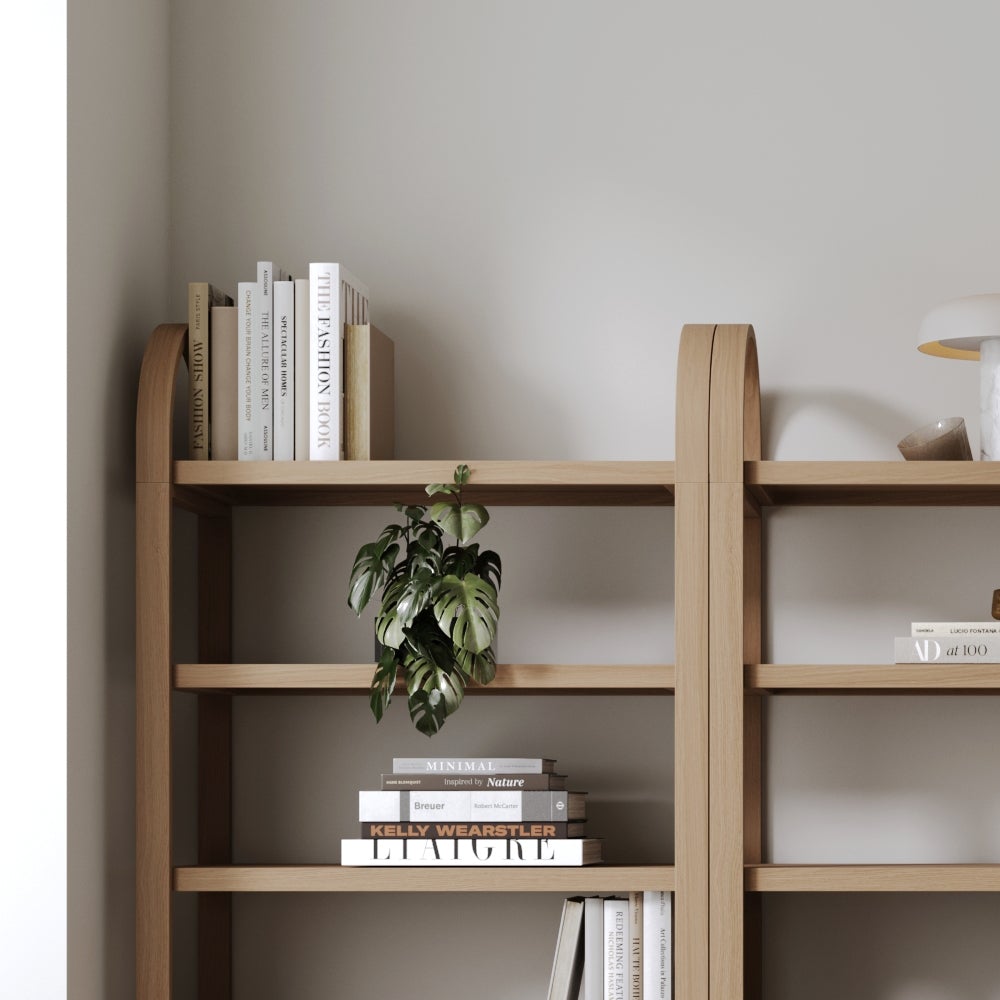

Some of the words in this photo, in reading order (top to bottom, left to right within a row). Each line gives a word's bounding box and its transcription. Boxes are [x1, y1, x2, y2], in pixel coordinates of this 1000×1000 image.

[318, 272, 330, 312] THE
[262, 312, 270, 330] THE
[193, 339, 203, 382] SHOW
[262, 332, 270, 370] ALLURE
[318, 316, 330, 395] FASHION
[262, 374, 270, 386] OF
[262, 388, 270, 410] MEN
[193, 389, 203, 450] FASHION
[318, 401, 330, 448] BOOK
[914, 640, 940, 661] AD
[946, 645, 958, 656] at
[963, 644, 987, 656] 100
[426, 761, 496, 771] MINIMAL
[444, 778, 474, 787] Inspired
[475, 778, 483, 786] by
[486, 777, 525, 788] Nature
[414, 802, 445, 810] Breuer
[370, 824, 430, 837] KELLY
[435, 824, 556, 837] WEARSTLER
[616, 911, 624, 970] REDEEMING
[632, 937, 640, 973] HAUTE
